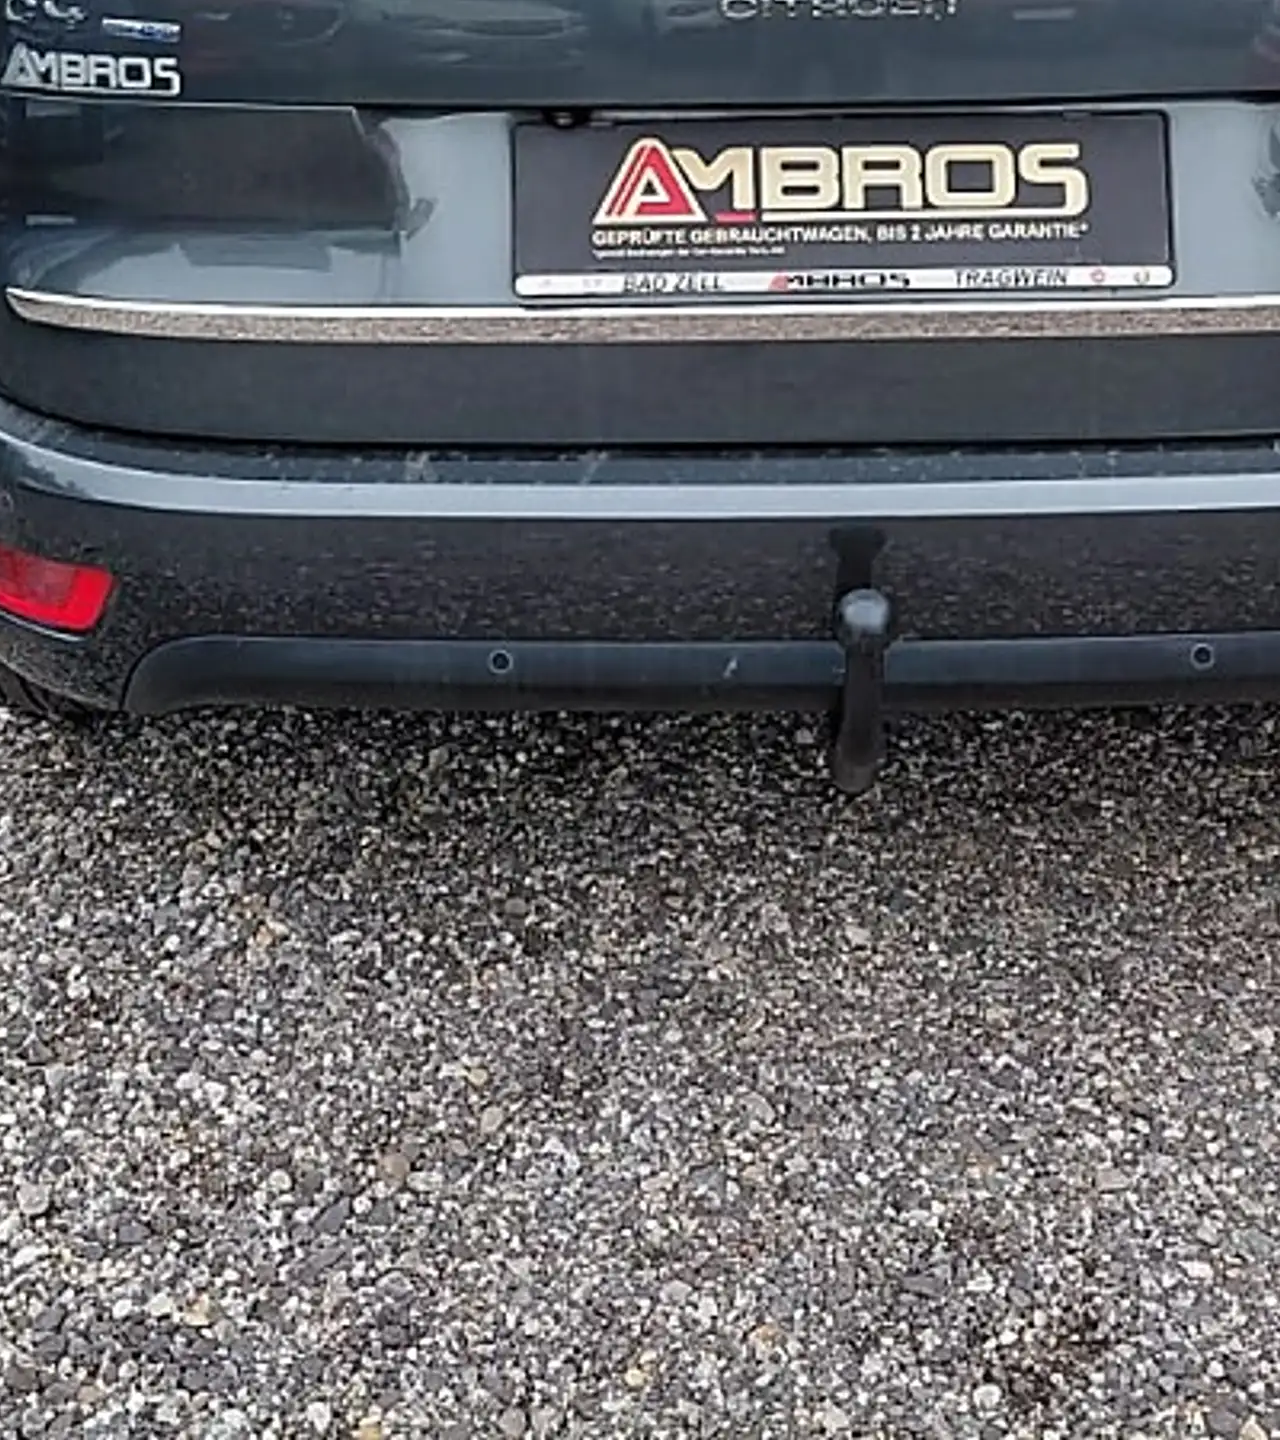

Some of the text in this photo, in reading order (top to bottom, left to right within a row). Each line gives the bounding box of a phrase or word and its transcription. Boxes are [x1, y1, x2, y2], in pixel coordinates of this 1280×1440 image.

[0, 41, 181, 96] AMBROS
[591, 136, 1091, 226] AMBROS
[592, 226, 688, 247] GEPRÜFTE
[691, 224, 872, 244] GEBRAUCHTWAGEN,
[877, 224, 907, 242] BIS
[910, 224, 921, 242] 2
[925, 223, 985, 242] JAHRE
[623, 273, 724, 294] BAD ZELL
[955, 267, 1069, 288] TRAGWEIN
